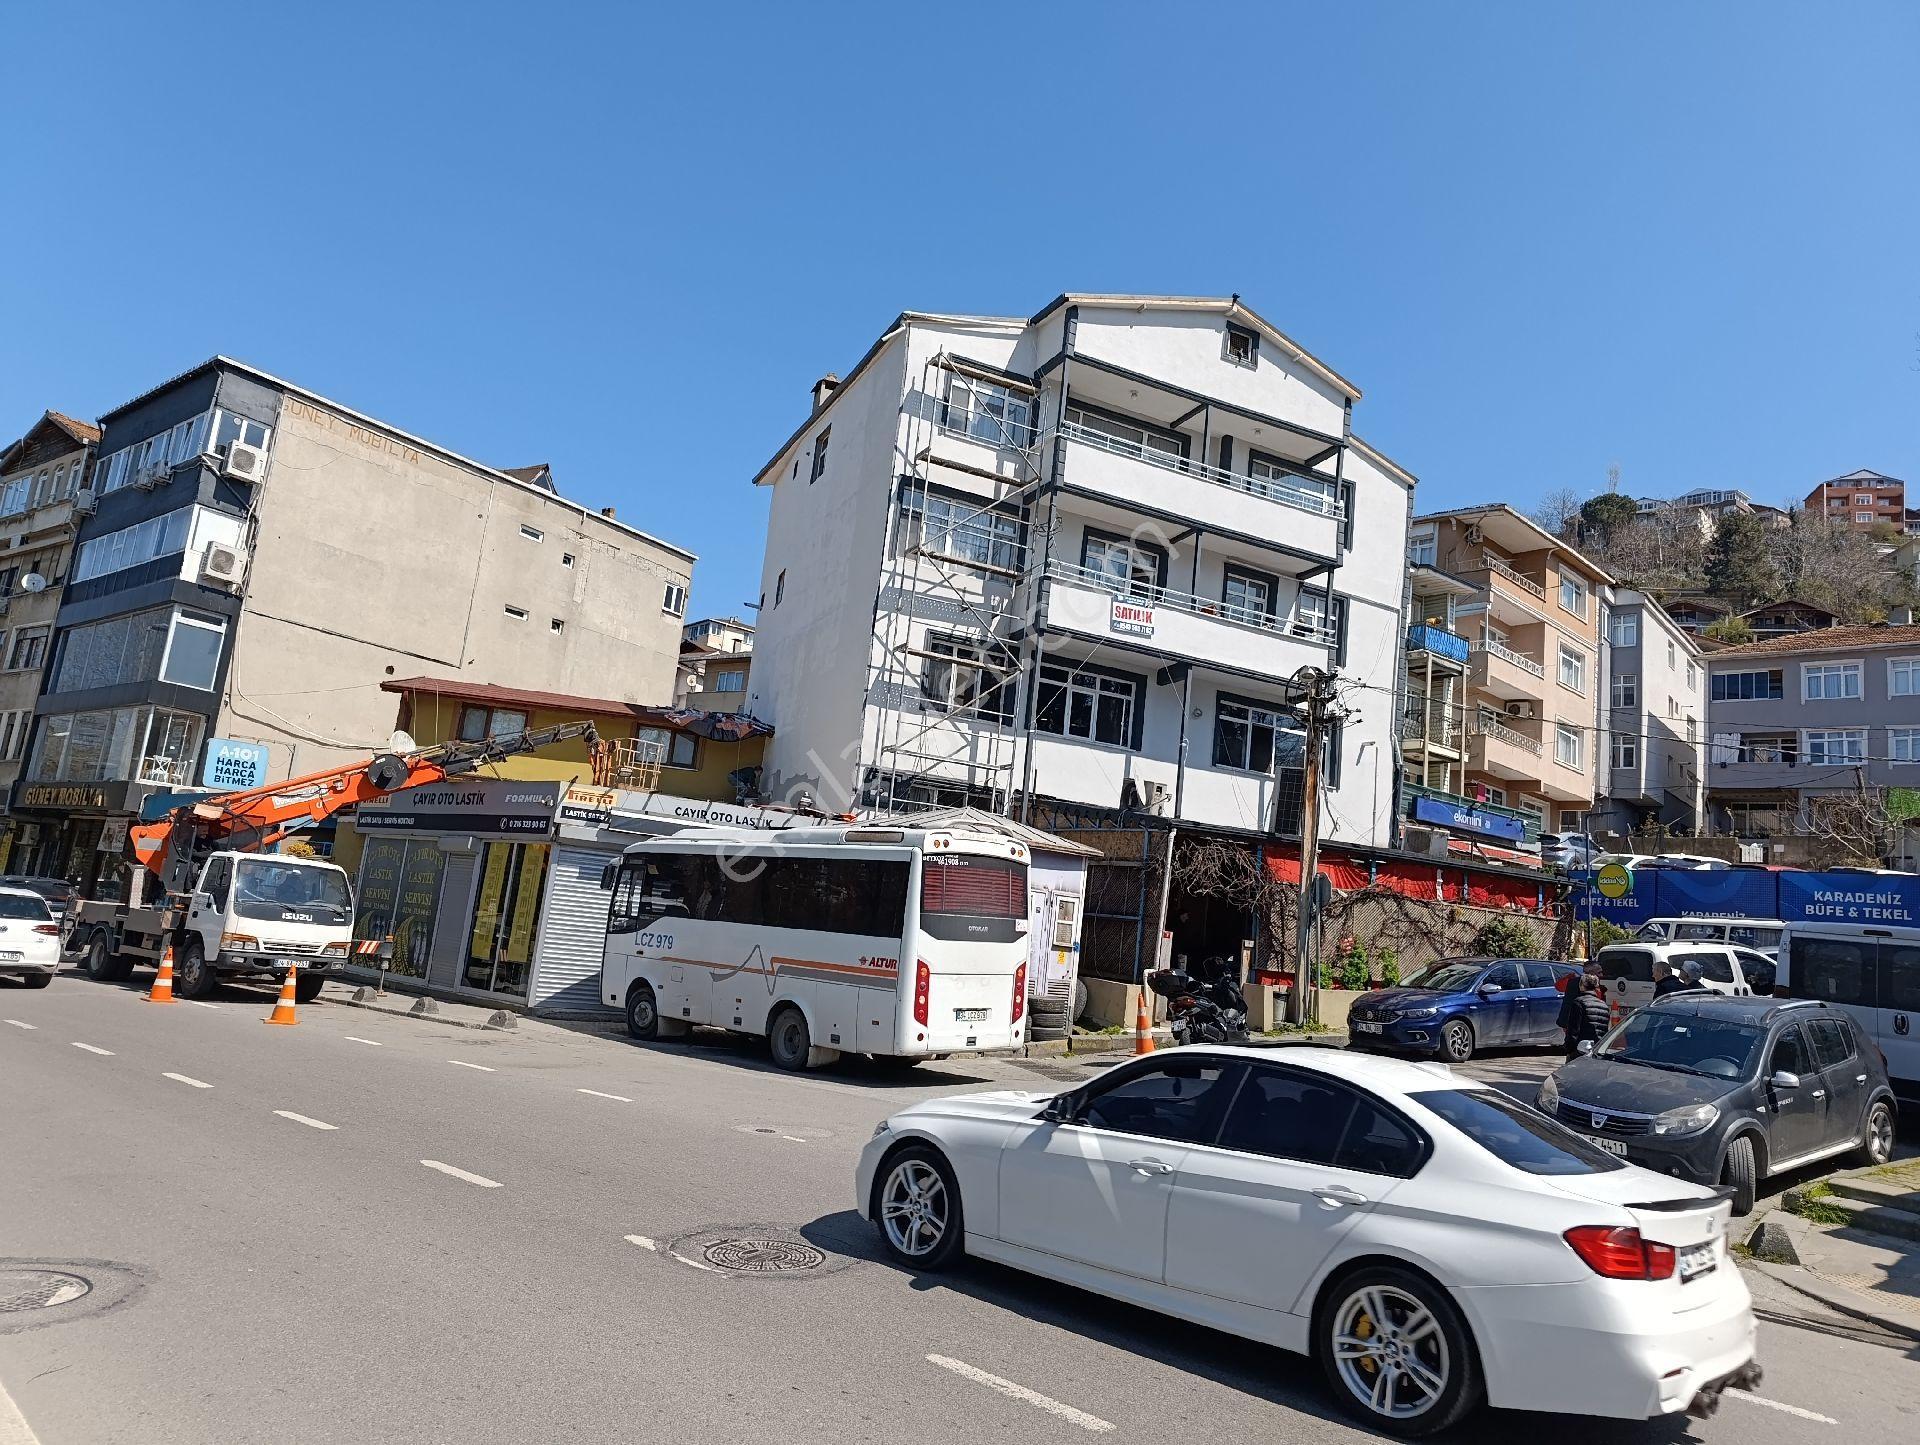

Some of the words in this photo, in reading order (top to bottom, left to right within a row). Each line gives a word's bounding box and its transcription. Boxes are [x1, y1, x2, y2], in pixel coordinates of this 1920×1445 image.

[1115, 606, 1153, 624] SATILIK
[217, 757, 256, 770] HARCA
[215, 766, 255, 778] HARCA
[413, 793, 436, 807] ÇAYIR
[437, 793, 455, 806] OTO
[455, 790, 486, 806] LASTİK
[710, 812, 733, 823] OTO
[1453, 810, 1482, 828] ekomini
[1580, 897, 1602, 906] BFE
[1613, 898, 1640, 907] TEKEL
[1814, 891, 1902, 905] KARADENİZ
[282, 912, 313, 921] ISUZU
[1805, 903, 1844, 916] BÜFE
[1848, 906, 1858, 918] &
[1863, 907, 1913, 921] TEKEL
[634, 932, 655, 948] LCZ
[657, 934, 674, 950] 979
[868, 956, 897, 970] ALTUR
[1601, 1142, 1625, 1154] 4411
